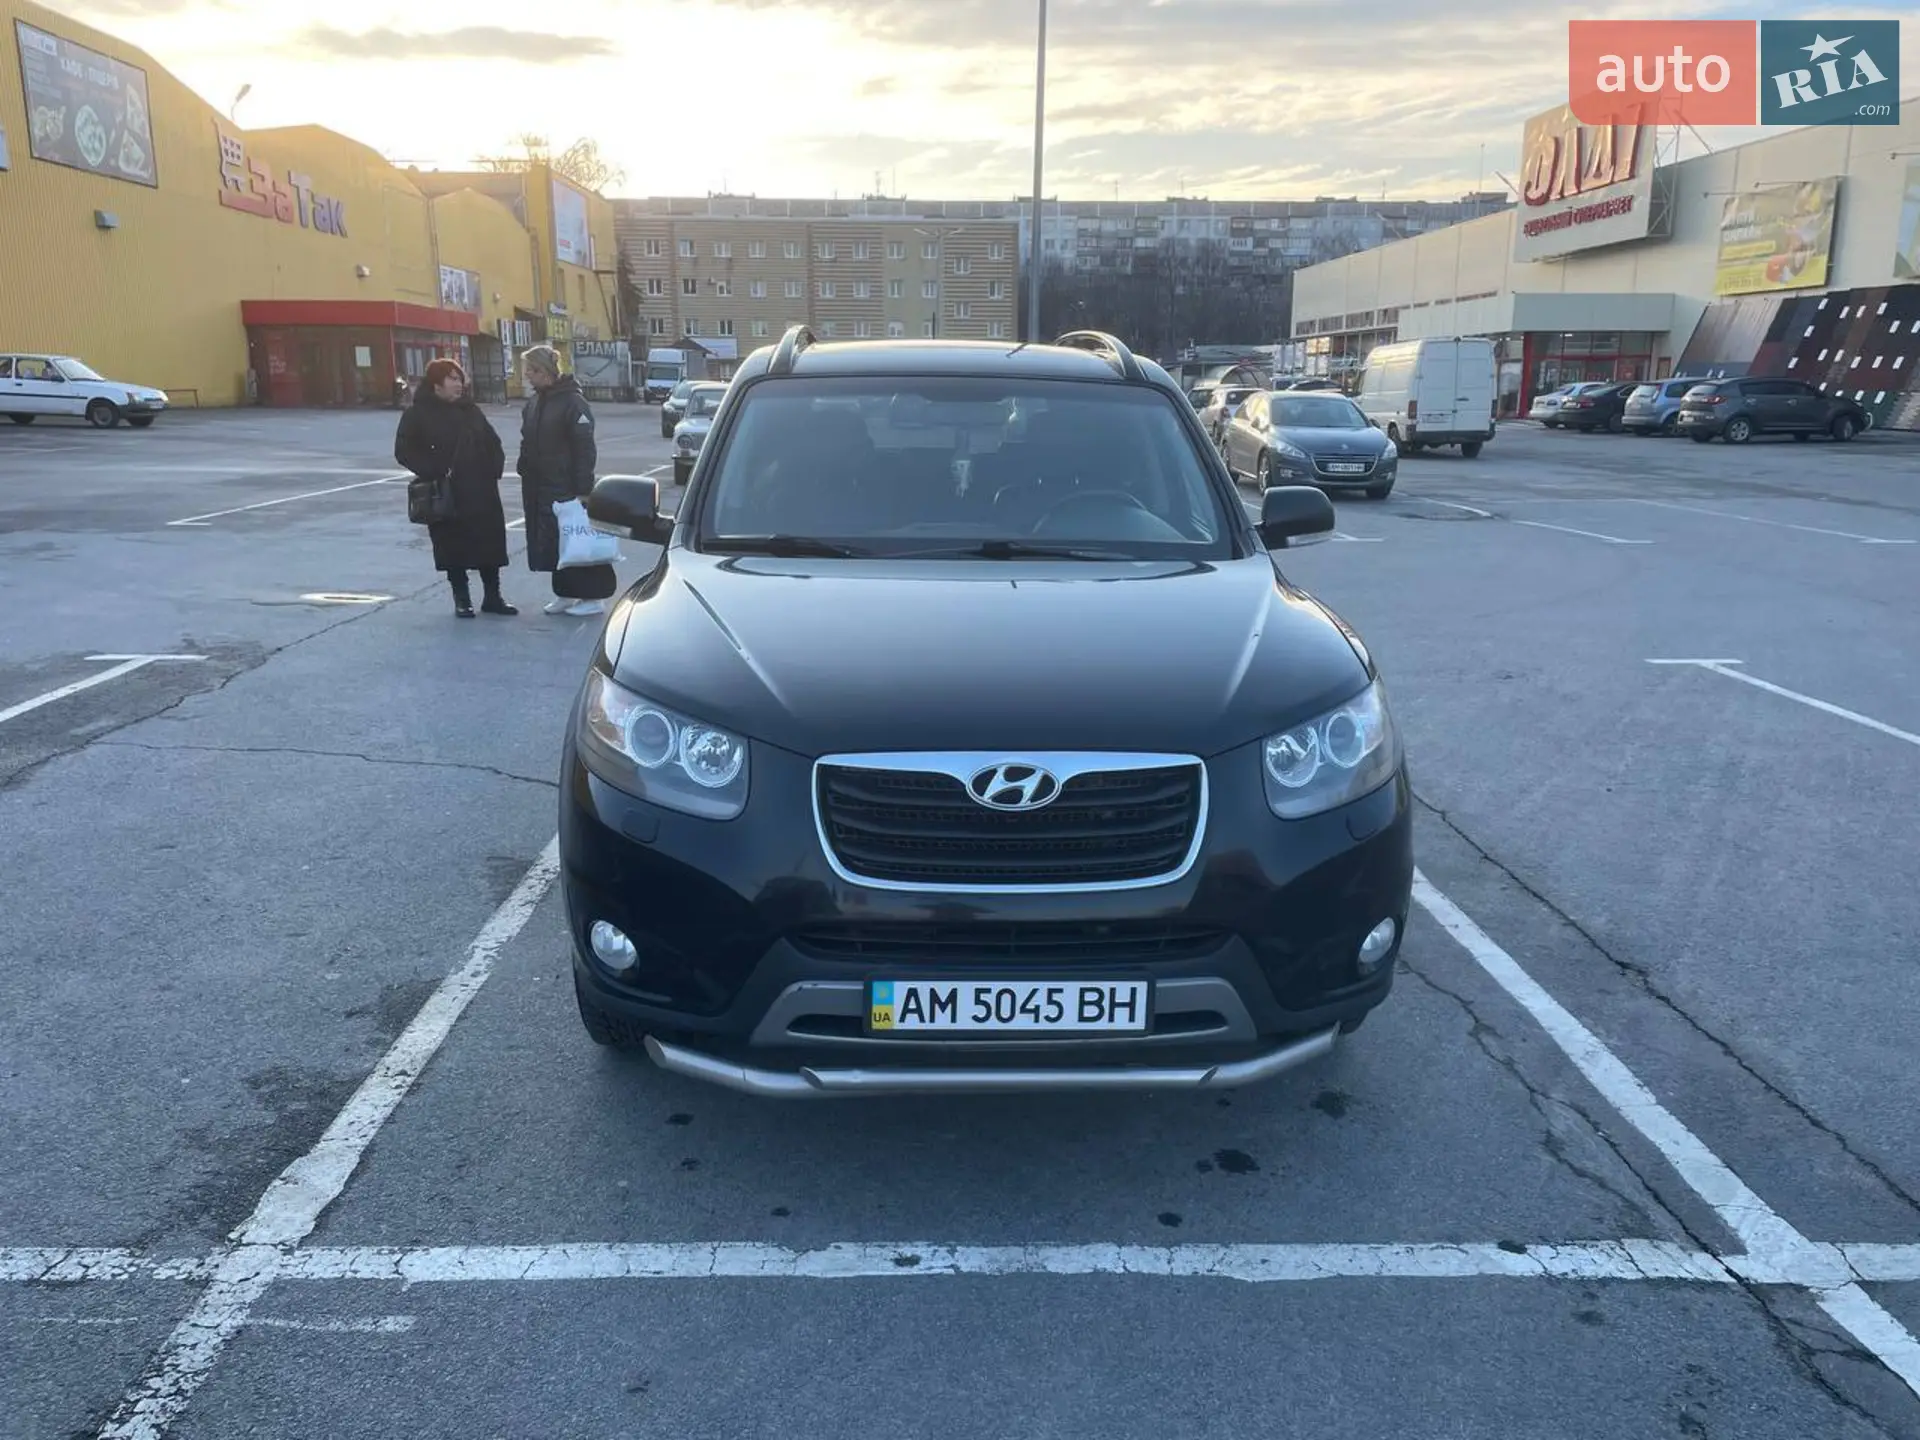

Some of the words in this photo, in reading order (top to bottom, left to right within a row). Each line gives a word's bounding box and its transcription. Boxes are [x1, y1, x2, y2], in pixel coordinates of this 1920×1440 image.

[898, 987, 958, 1023] AM
[971, 987, 1064, 1023] 5045
[1077, 987, 1137, 1023] BH
[873, 1012, 891, 1023] UA
